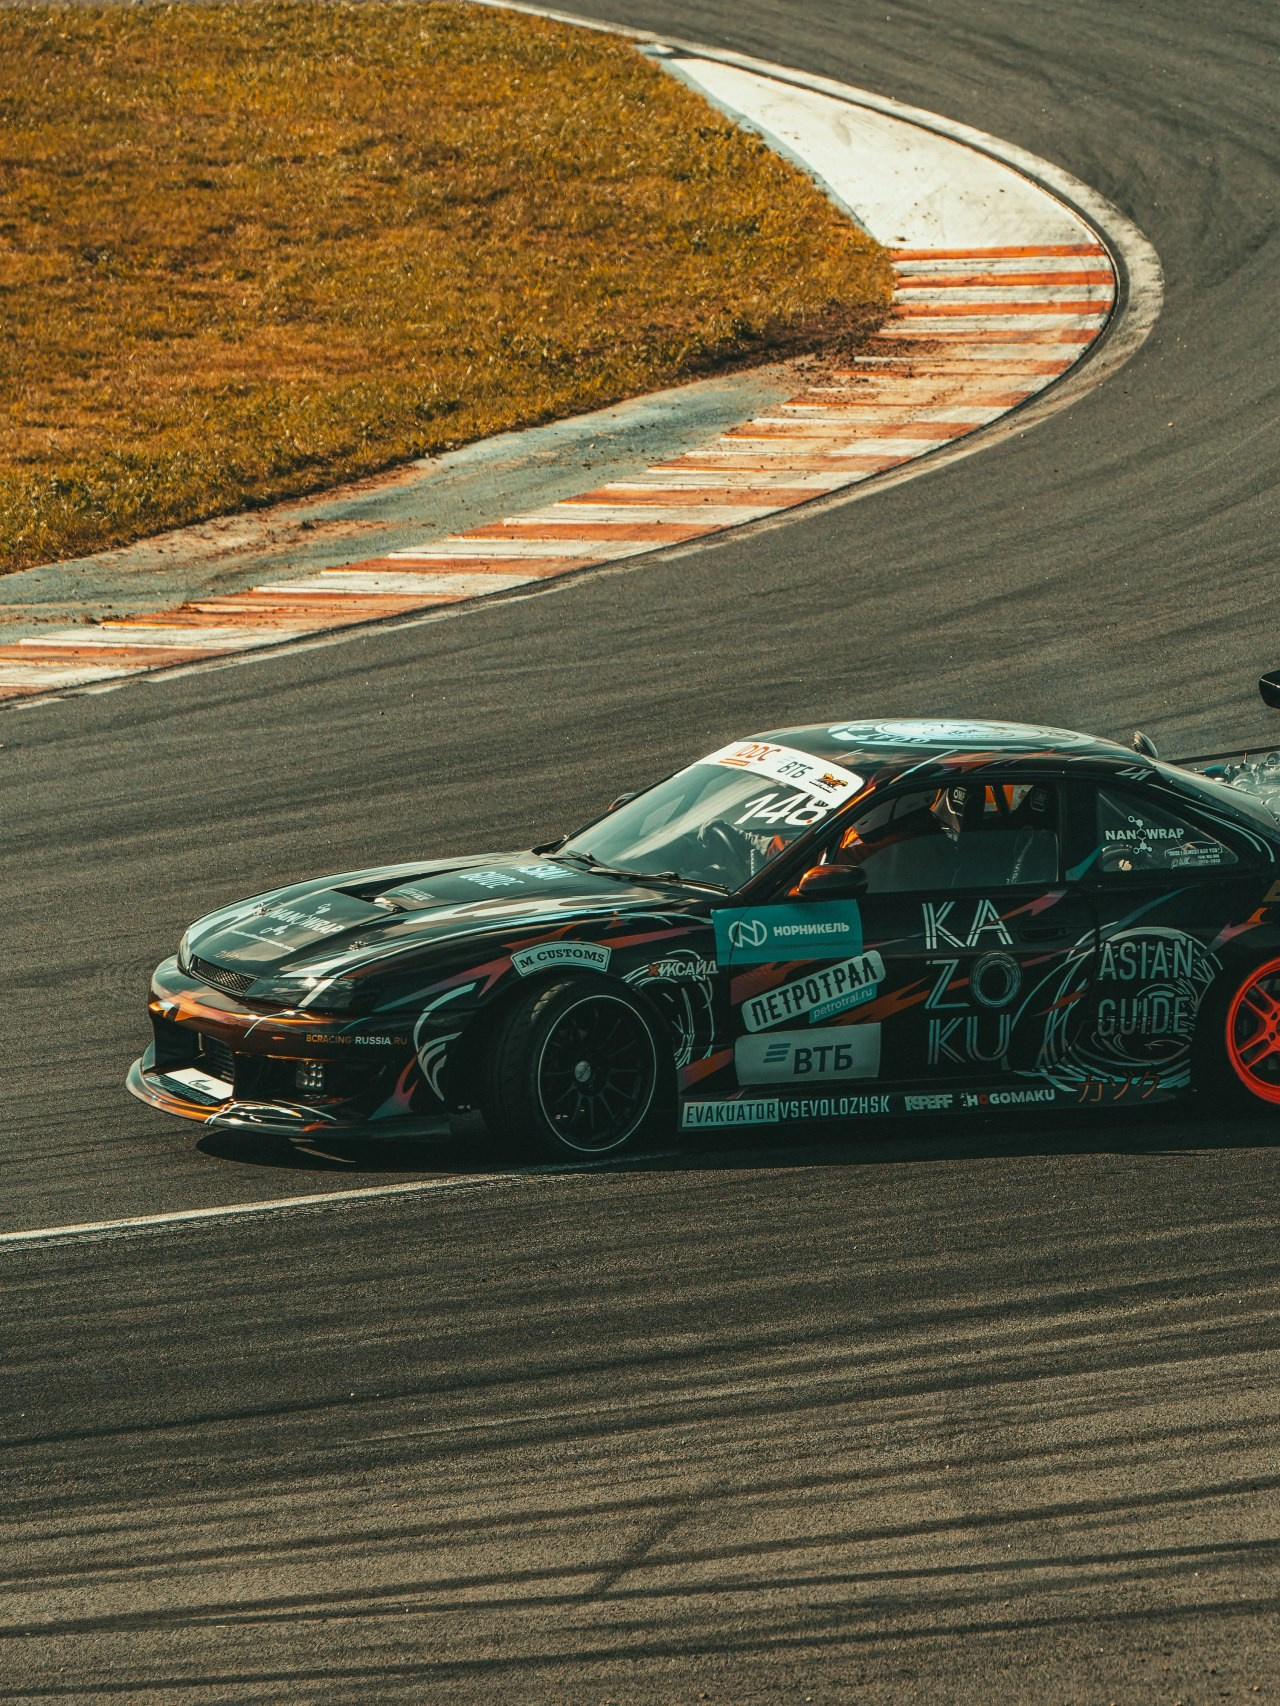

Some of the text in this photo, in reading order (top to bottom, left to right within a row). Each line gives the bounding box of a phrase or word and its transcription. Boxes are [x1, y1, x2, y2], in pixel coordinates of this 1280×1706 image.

[777, 761, 814, 779] ВТБ
[734, 793, 829, 825] 148
[773, 922, 850, 936] НОРНИКЕЛЬ
[922, 899, 1014, 949] KA
[519, 949, 605, 968] M CUSTOMS
[1099, 941, 1194, 980] ASIAN
[751, 957, 878, 1026] ПЕТРОТРАЛ
[925, 951, 1023, 1008] ZO
[813, 988, 873, 1019] petrotral.ru
[1097, 997, 1191, 1036] GUIDE
[928, 1015, 1011, 1064] KU
[793, 1044, 853, 1074] ВТБ
